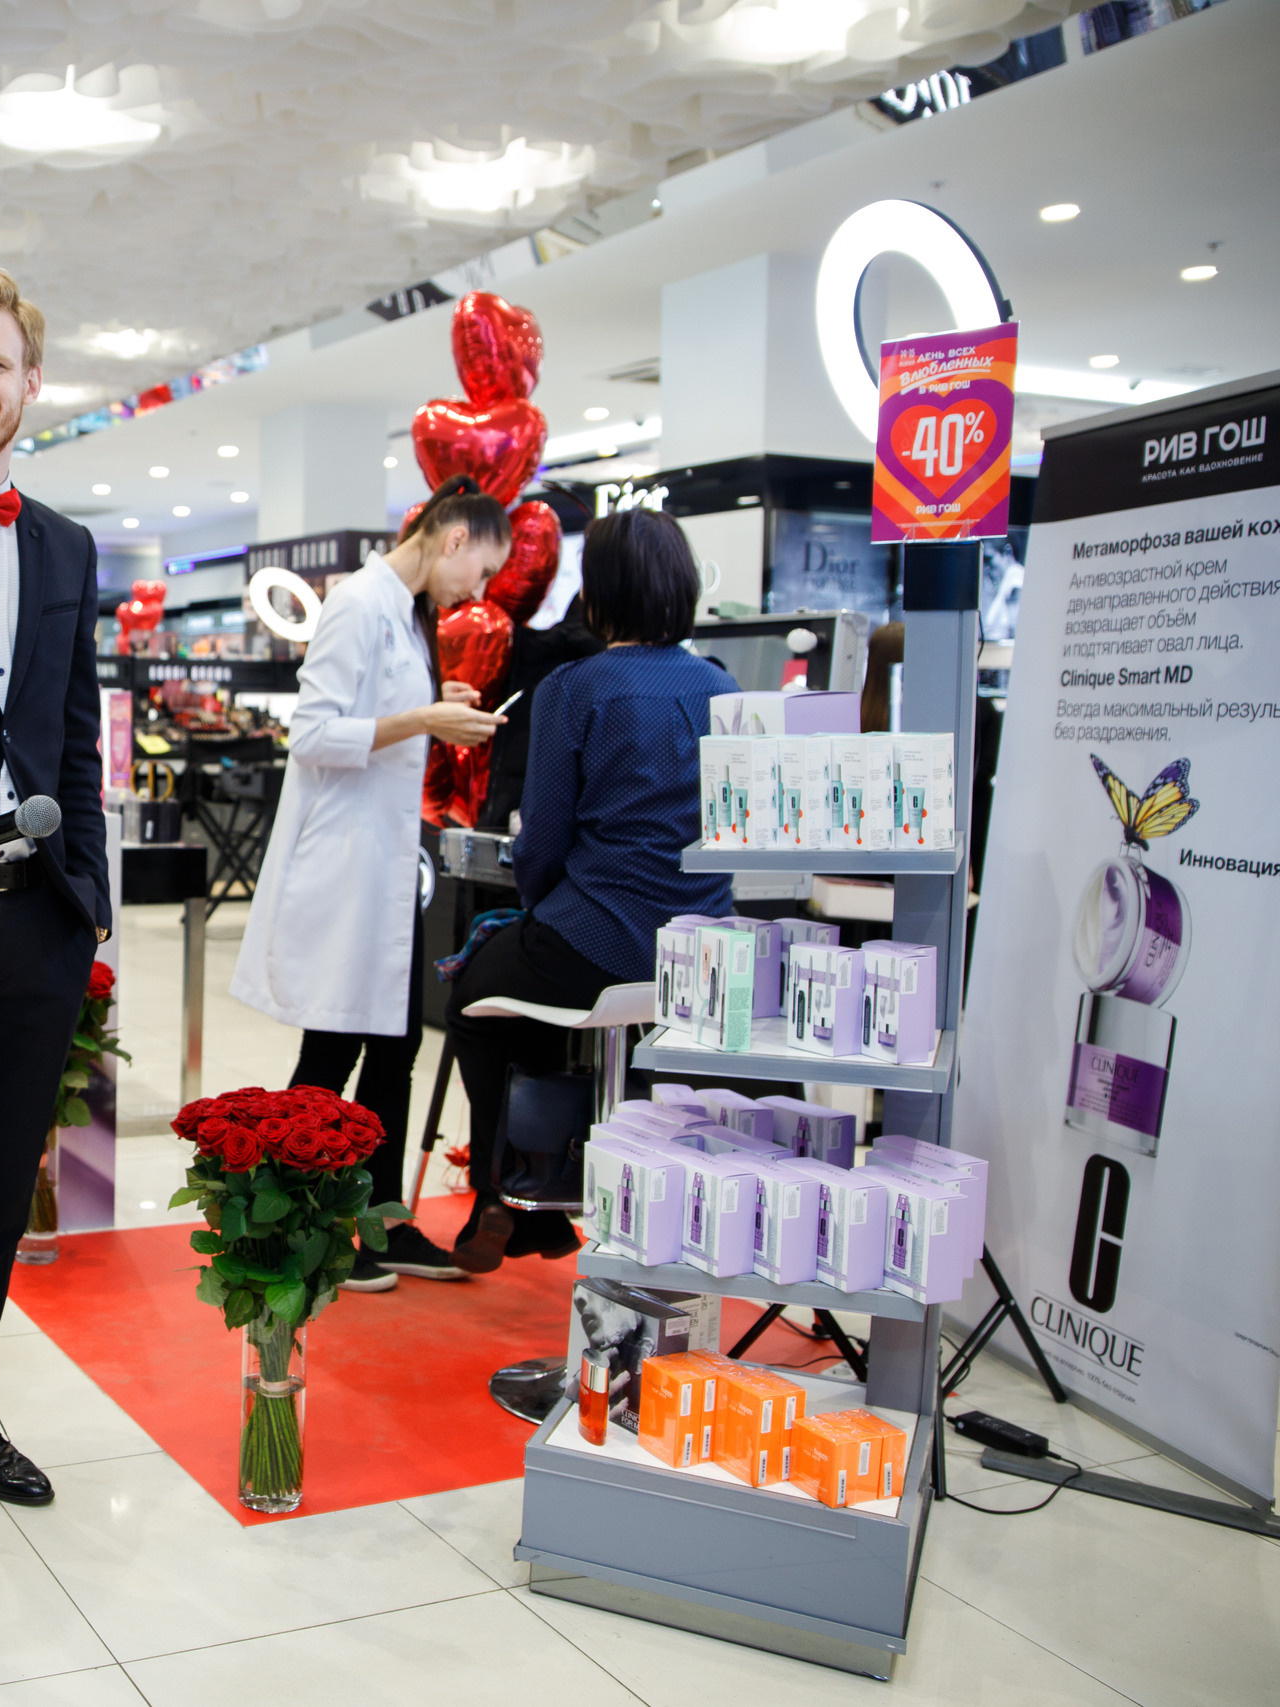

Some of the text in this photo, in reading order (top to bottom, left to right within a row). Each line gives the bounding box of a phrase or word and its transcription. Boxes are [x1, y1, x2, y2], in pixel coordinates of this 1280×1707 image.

[917, 346, 976, 363] ДЕНЬ ВСЕХ
[949, 380, 970, 390] ГОШ
[901, 411, 985, 477] -40%
[1143, 416, 1267, 467] РИВ ГОШ
[1142, 453, 1263, 483] КРАСОТА КАК ВДОХНОВЕНИЕ
[937, 503, 961, 513] ГОШ
[1073, 532, 1181, 559] Метаморфоза
[1184, 518, 1243, 545] вашей
[1069, 558, 1228, 589] Антивозрастной крем
[1067, 585, 1197, 615] двунаправленного
[1065, 608, 1197, 636] возвращает объём
[1073, 637, 1155, 659] подтягивает
[1157, 636, 1194, 650] овал
[1197, 634, 1243, 653] лица.
[1060, 665, 1193, 689] Clinique Smart MD
[1057, 699, 1100, 719] Всегда
[1103, 698, 1213, 719] максимальный
[1054, 721, 1171, 744] без раздражения.
[1031, 1296, 1145, 1377] CLINIQUE
